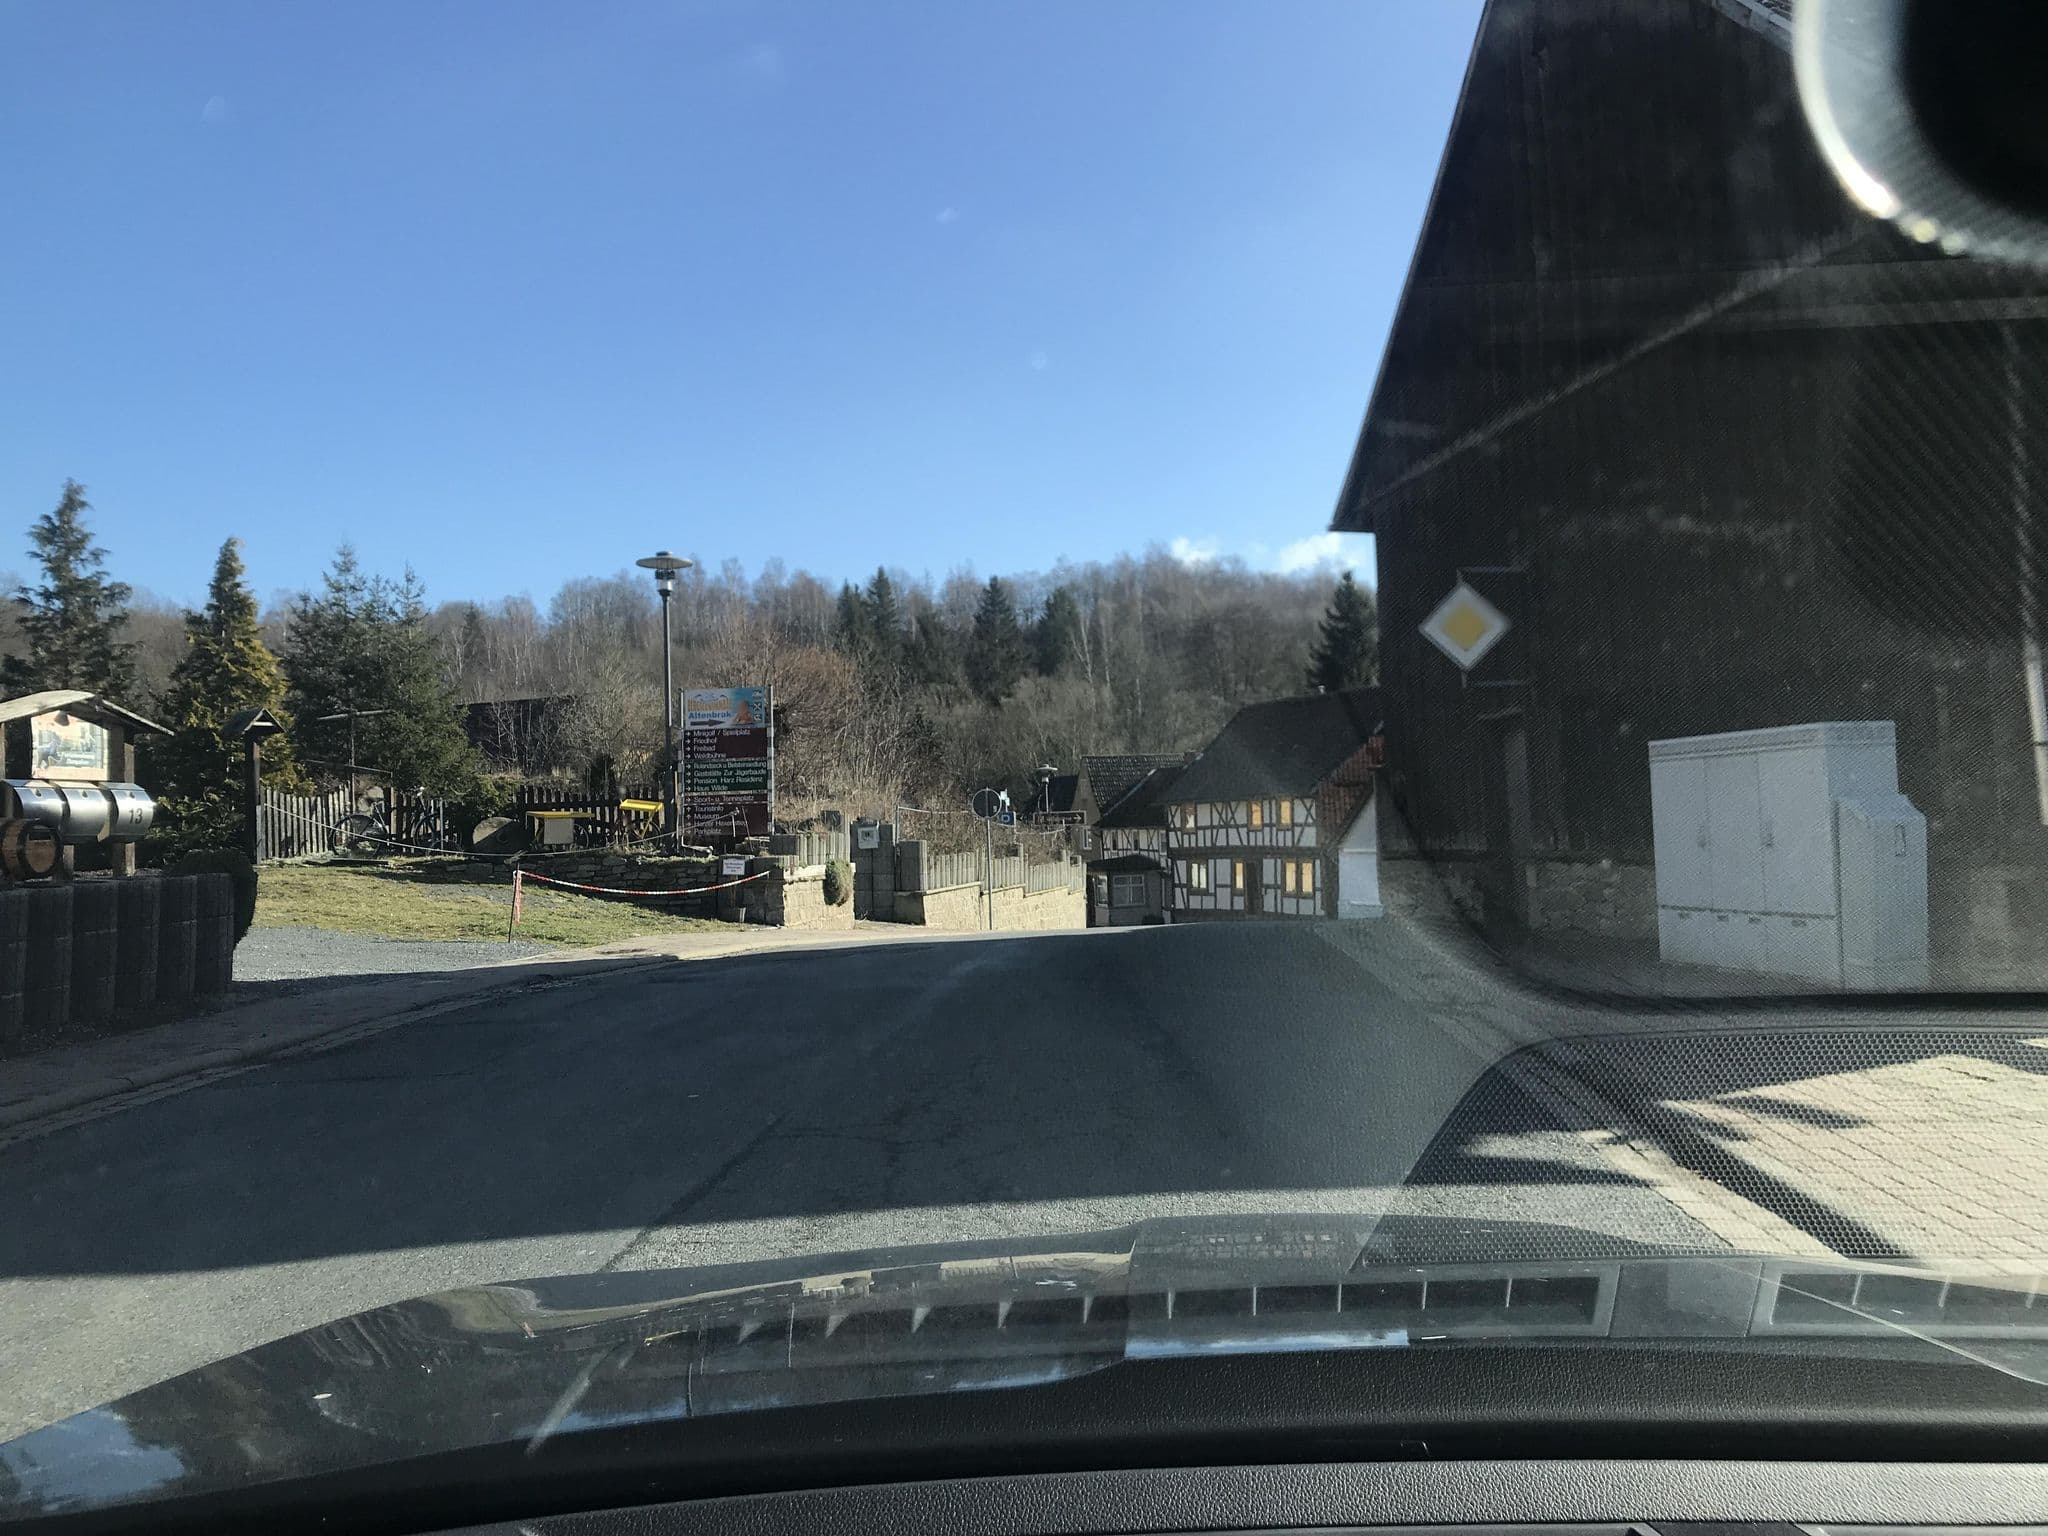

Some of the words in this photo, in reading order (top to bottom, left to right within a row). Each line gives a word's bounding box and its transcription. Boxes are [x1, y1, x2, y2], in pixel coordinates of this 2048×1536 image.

[688, 711, 731, 719] Altenbrak
[693, 729, 716, 737] Minigolf
[722, 795, 754, 803] Tennisplatz
[129, 808, 143, 824] 13
